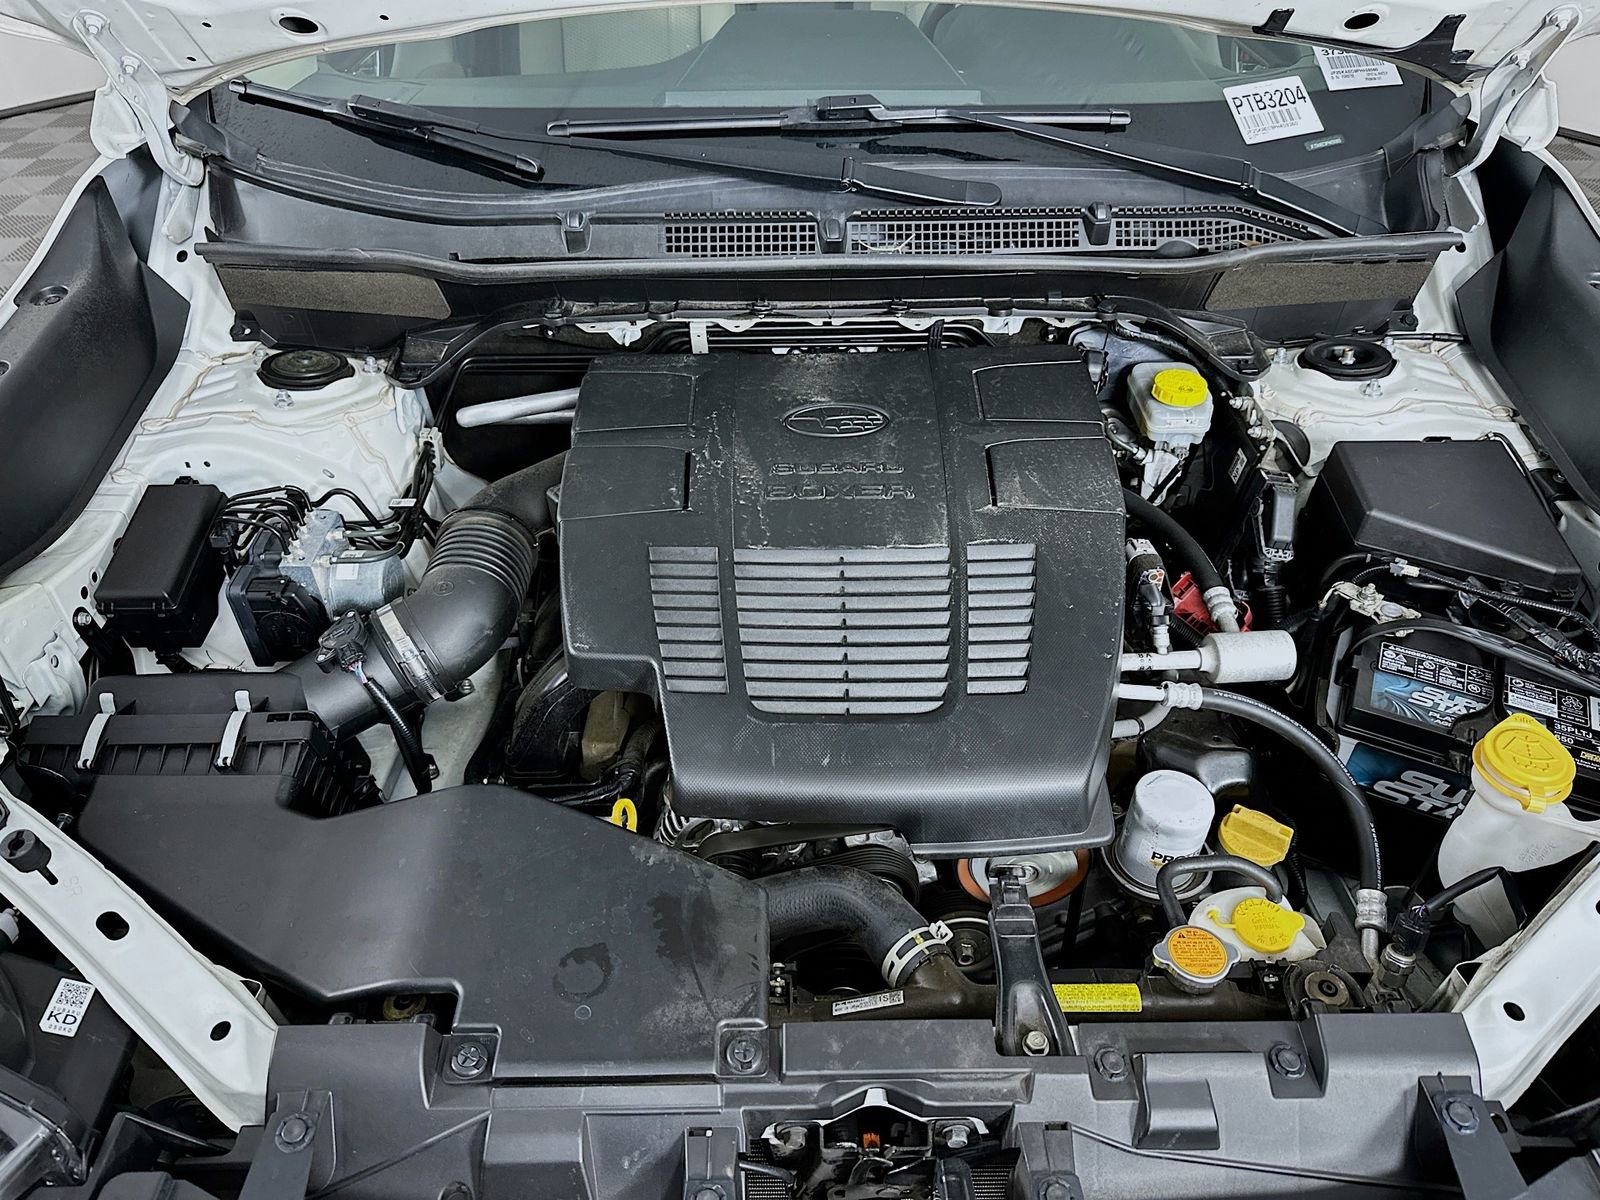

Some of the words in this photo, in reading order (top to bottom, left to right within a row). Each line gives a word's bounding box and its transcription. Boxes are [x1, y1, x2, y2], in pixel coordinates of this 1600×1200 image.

[1231, 86, 1307, 115] PTB3204
[769, 463, 905, 476] SUBARU
[764, 485, 916, 500] BOXER
[1408, 691, 1478, 715] STA
[1423, 686, 1488, 711] SUP
[1553, 722, 1592, 738] 35PLTJ
[1400, 770, 1468, 804] SU
[1373, 780, 1465, 820] STA
[1151, 851, 1184, 864] PR
[47, 1011, 77, 1025] KD
